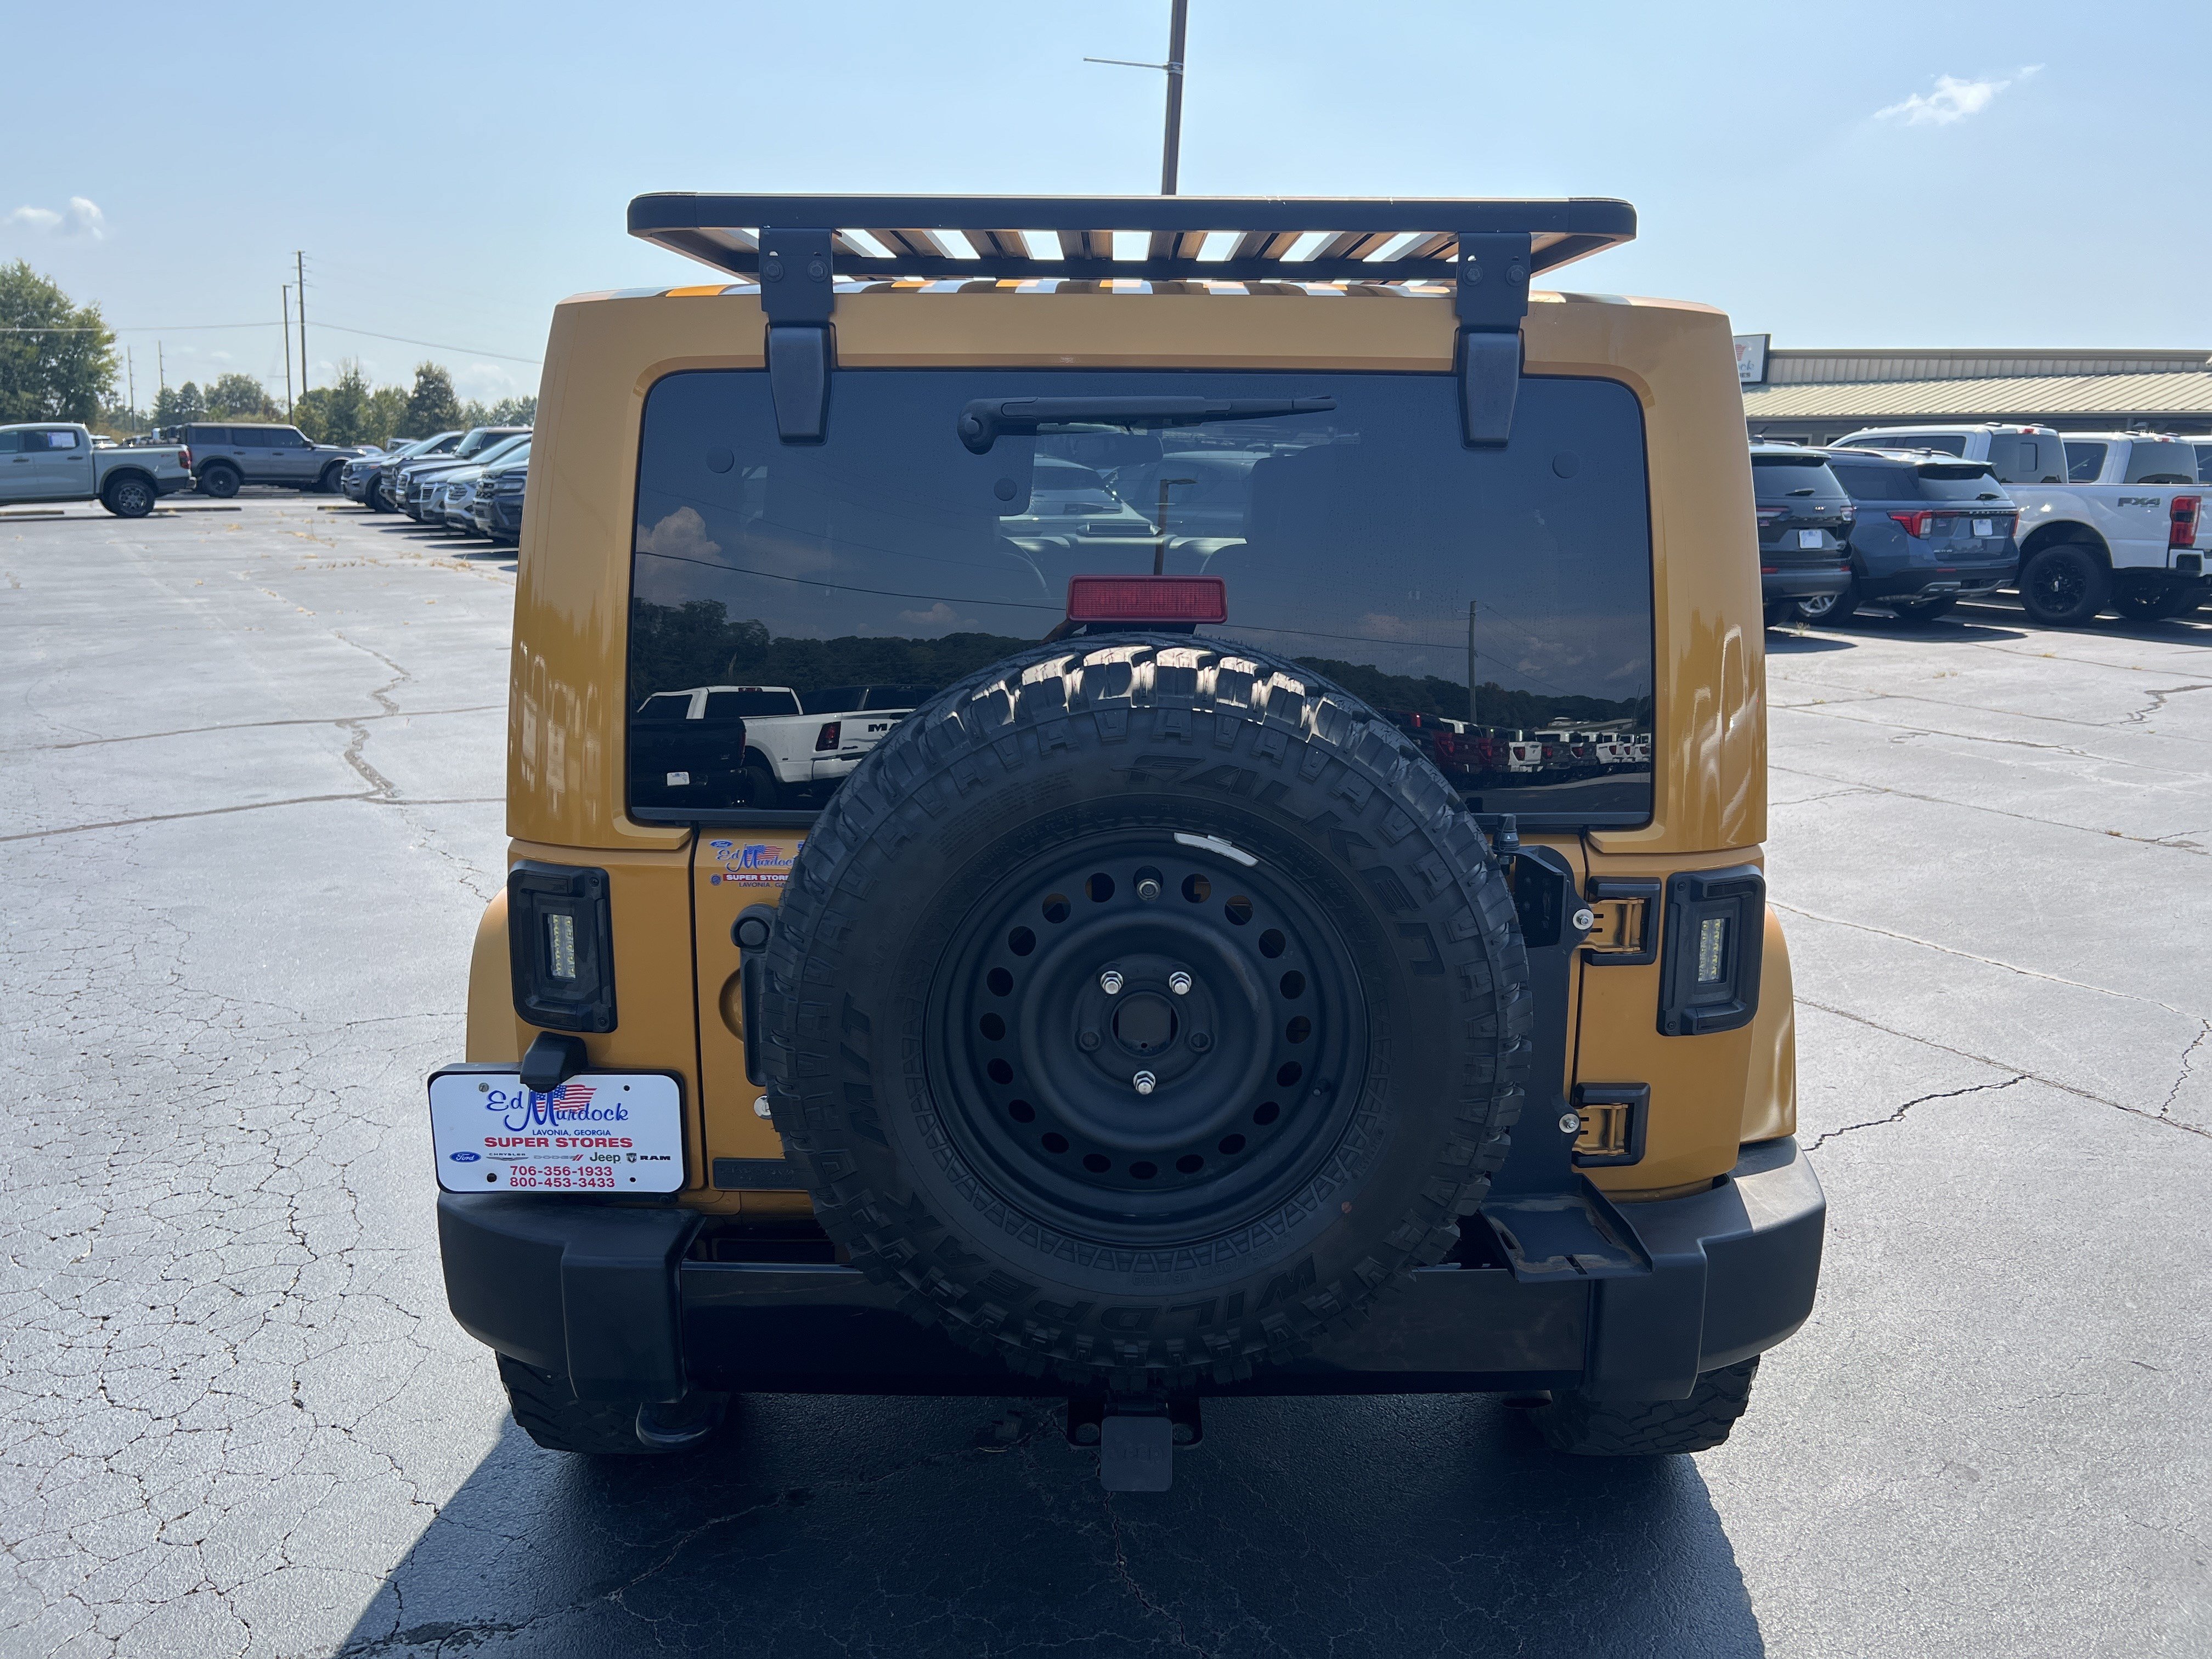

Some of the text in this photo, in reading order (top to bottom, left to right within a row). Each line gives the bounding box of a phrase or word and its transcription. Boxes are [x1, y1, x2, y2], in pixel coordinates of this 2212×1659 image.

[2118, 497, 2160, 507] FX4
[716, 847, 793, 872] Ed Murdoc
[1110, 753, 1445, 977] FALKEN
[486, 1090, 629, 1132] Ed Murdock
[484, 1137, 633, 1148] SUPER STORES
[590, 1152, 621, 1164] Jeep
[510, 1166, 613, 1176] 706-356-1933
[510, 1177, 615, 1188] 800-453-3433
[883, 1190, 1318, 1333] WILDPEAK
